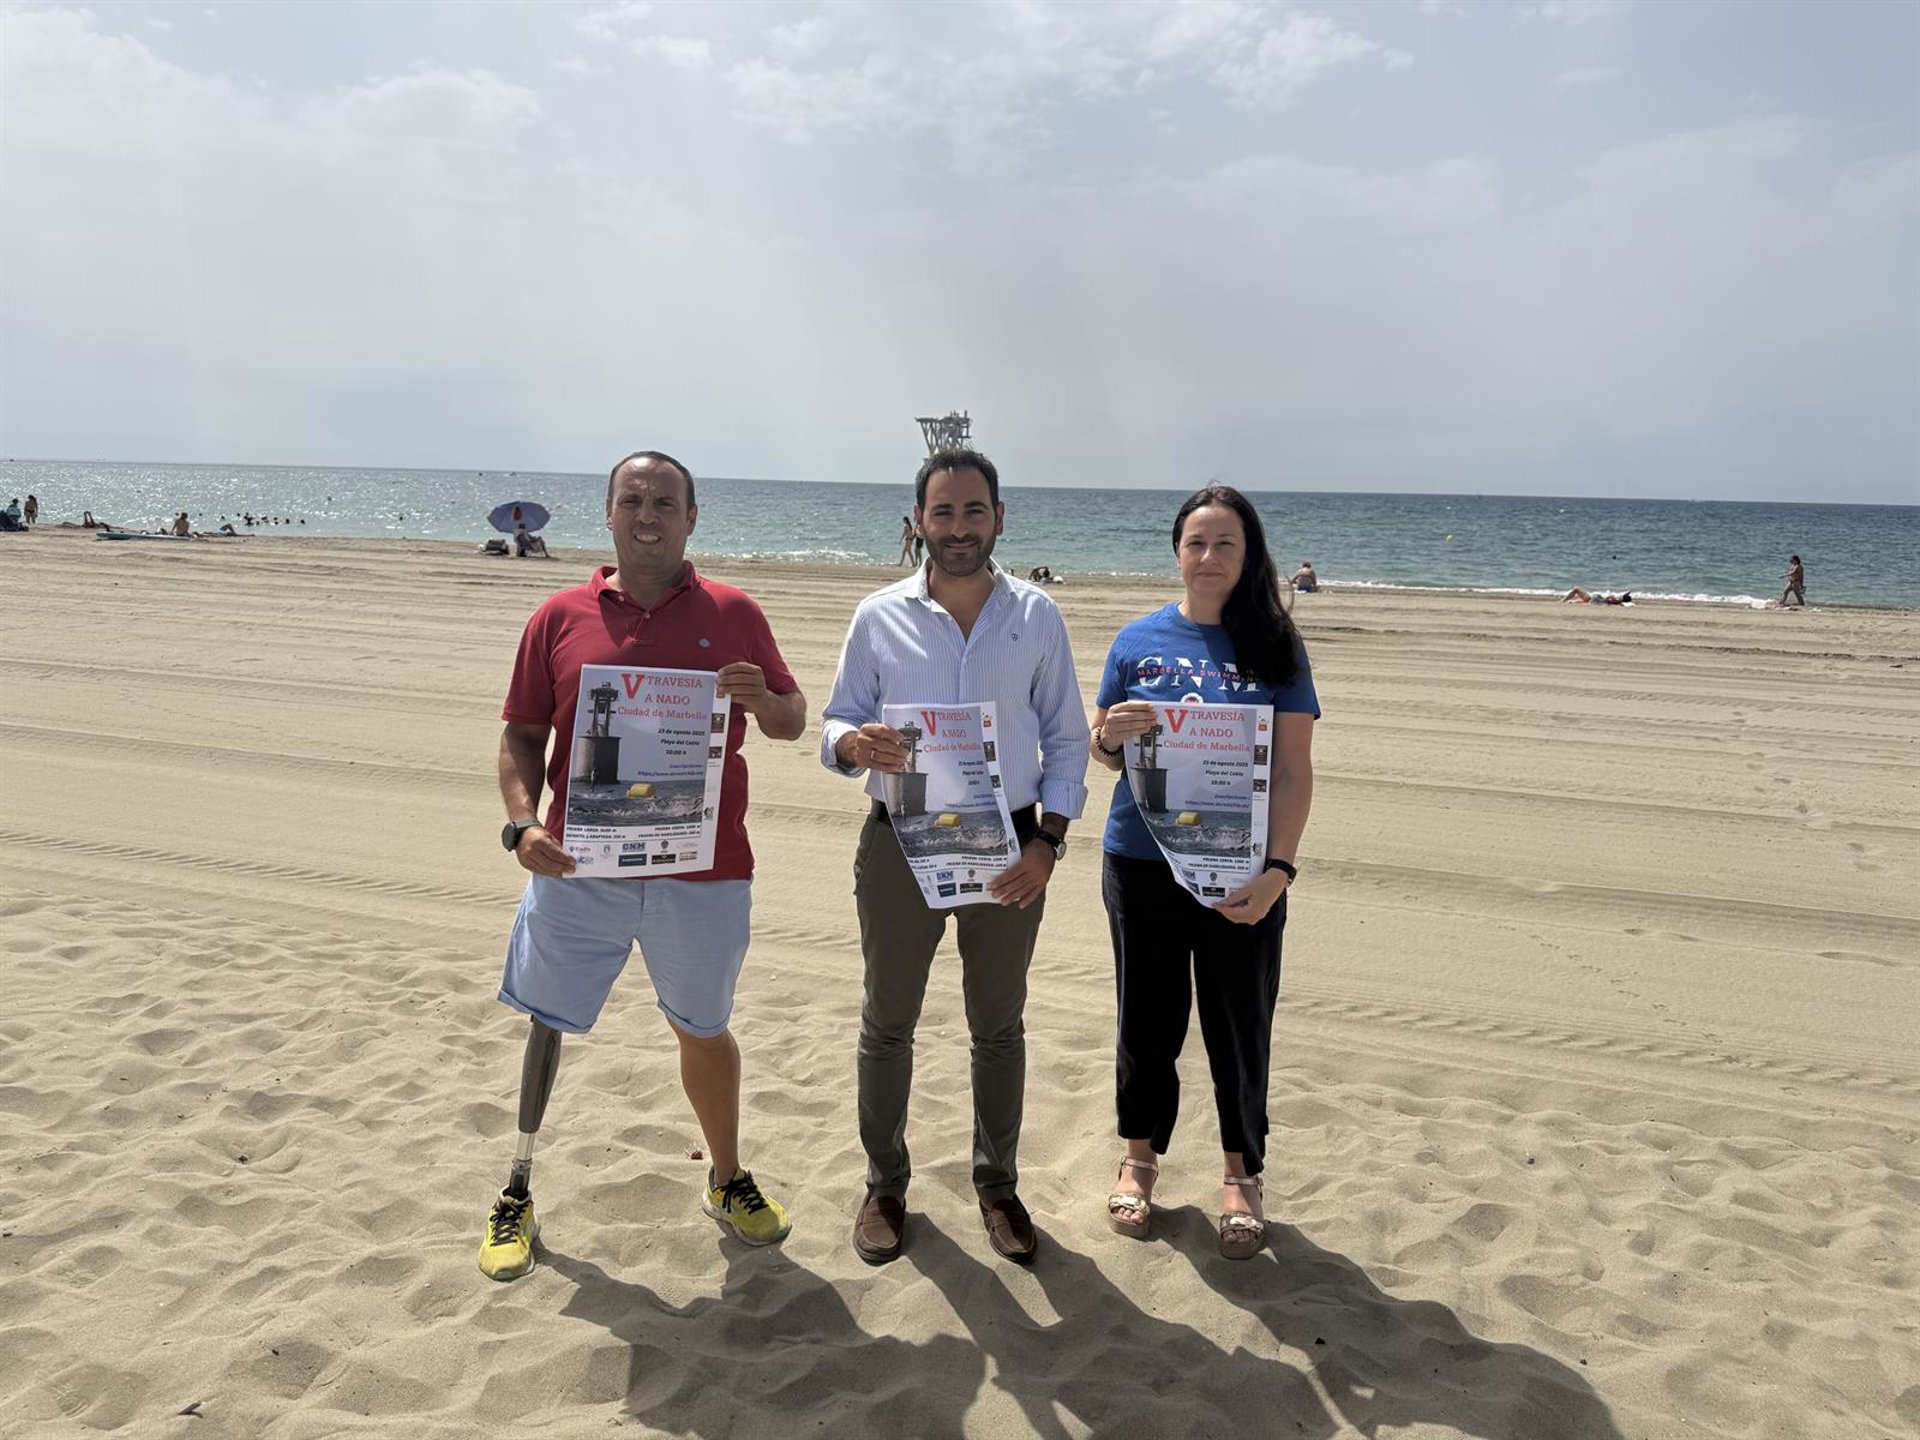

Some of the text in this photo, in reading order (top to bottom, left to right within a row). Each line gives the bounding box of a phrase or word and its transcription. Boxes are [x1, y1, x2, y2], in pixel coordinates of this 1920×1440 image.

[622, 673, 645, 700] V
[645, 693, 691, 706] A NADO
[618, 706, 707, 720] Ciudad de Marbella
[1189, 710, 1246, 722] TRAVESÍA
[921, 710, 937, 737] V
[1164, 708, 1189, 734] V
[1189, 727, 1233, 738] A NADO
[1163, 739, 1249, 752] Ciudad de Marbella
